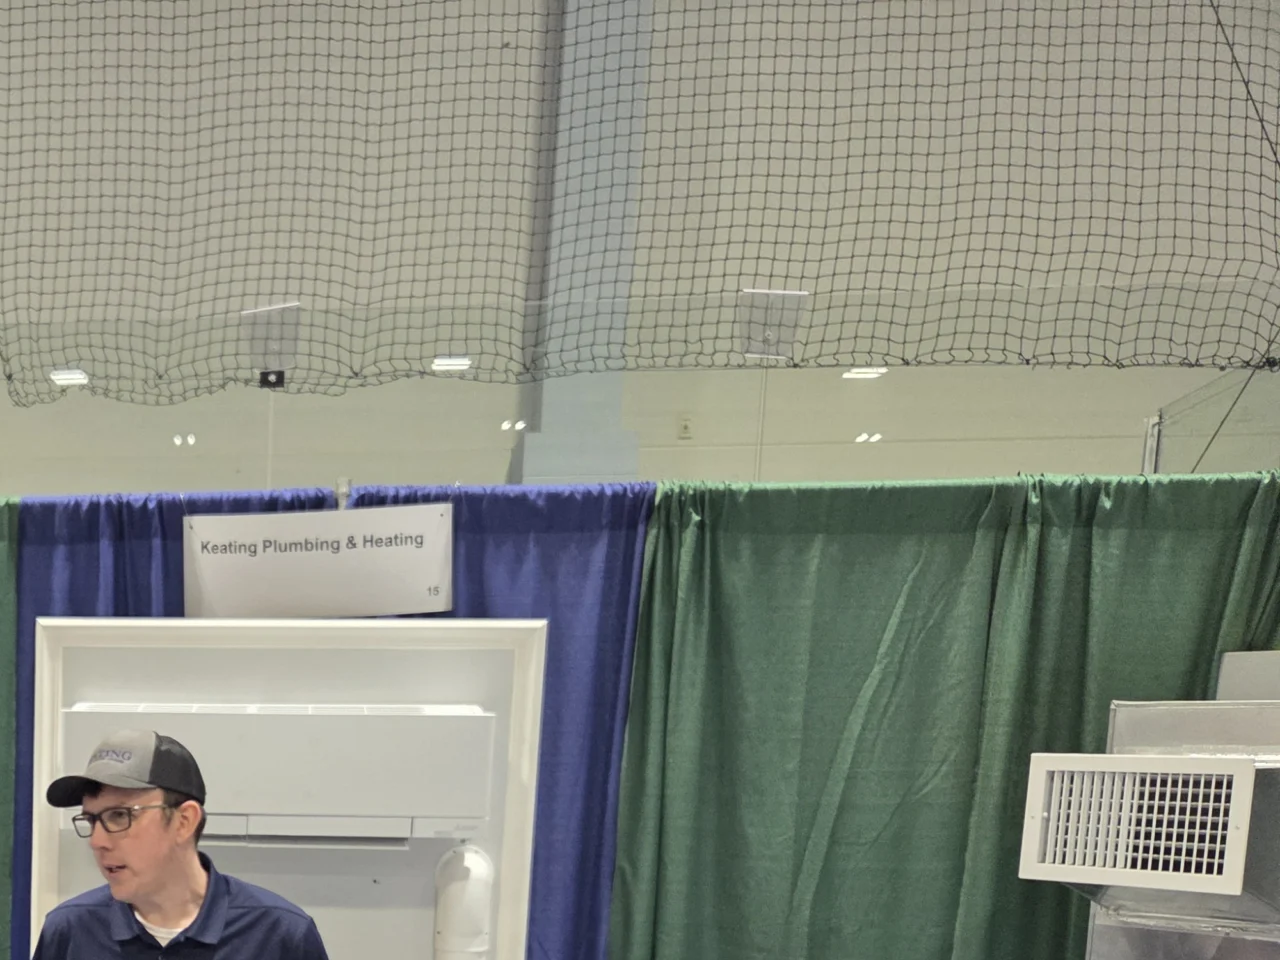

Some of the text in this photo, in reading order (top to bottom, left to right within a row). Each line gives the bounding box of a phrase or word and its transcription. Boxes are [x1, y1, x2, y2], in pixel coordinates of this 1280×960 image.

[201, 532, 424, 557] Keating Plumbing & Heating
[427, 586, 440, 596] 15
